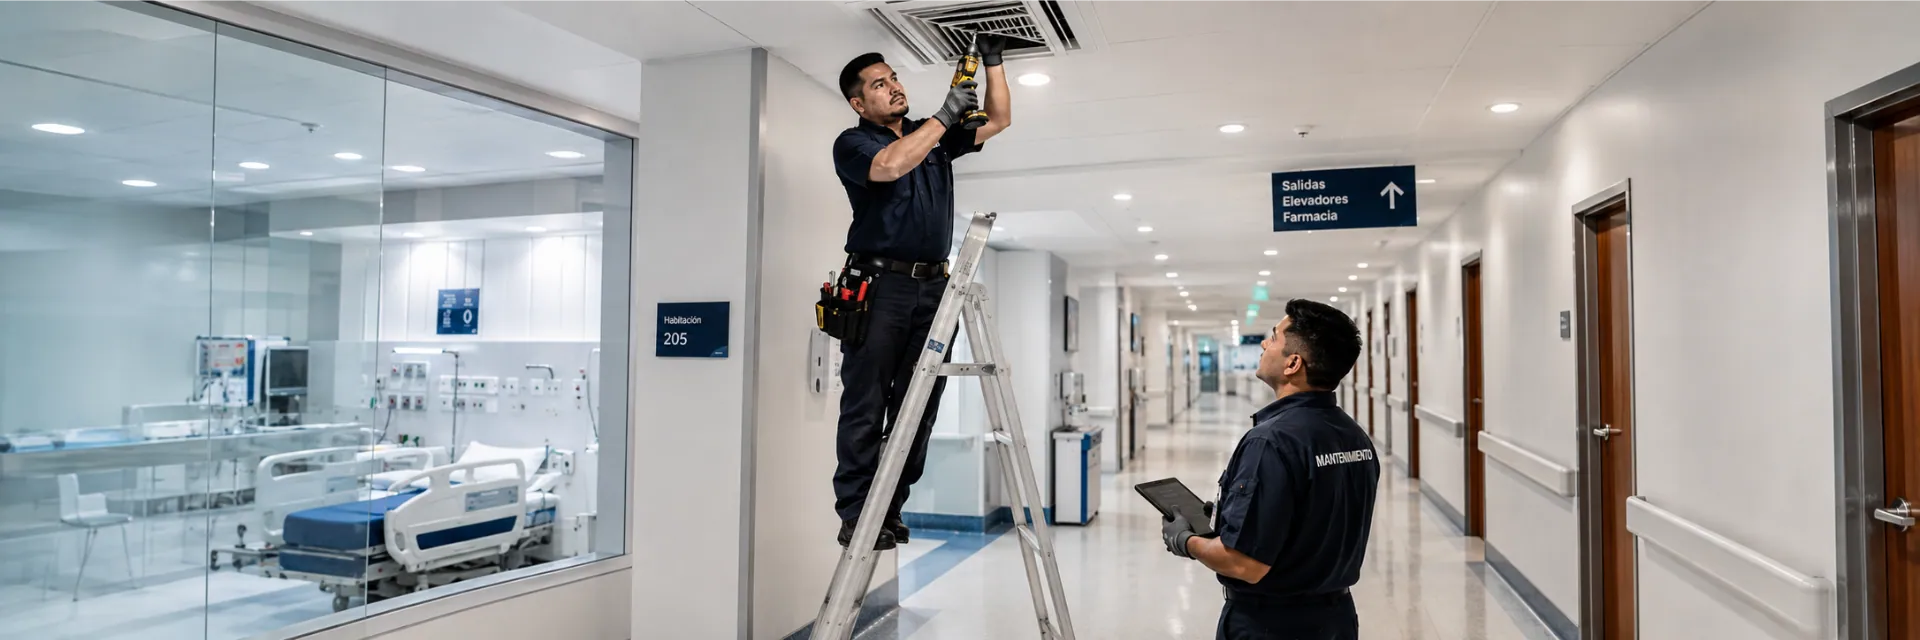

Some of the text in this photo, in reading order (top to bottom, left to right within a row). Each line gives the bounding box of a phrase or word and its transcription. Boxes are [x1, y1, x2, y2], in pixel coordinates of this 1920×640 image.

[1282, 179, 1326, 191] Salidas
[1282, 194, 1349, 207] Elevadores
[1283, 210, 1338, 222] Farmacia
[663, 315, 702, 325] Habitación
[663, 332, 688, 346] 205
